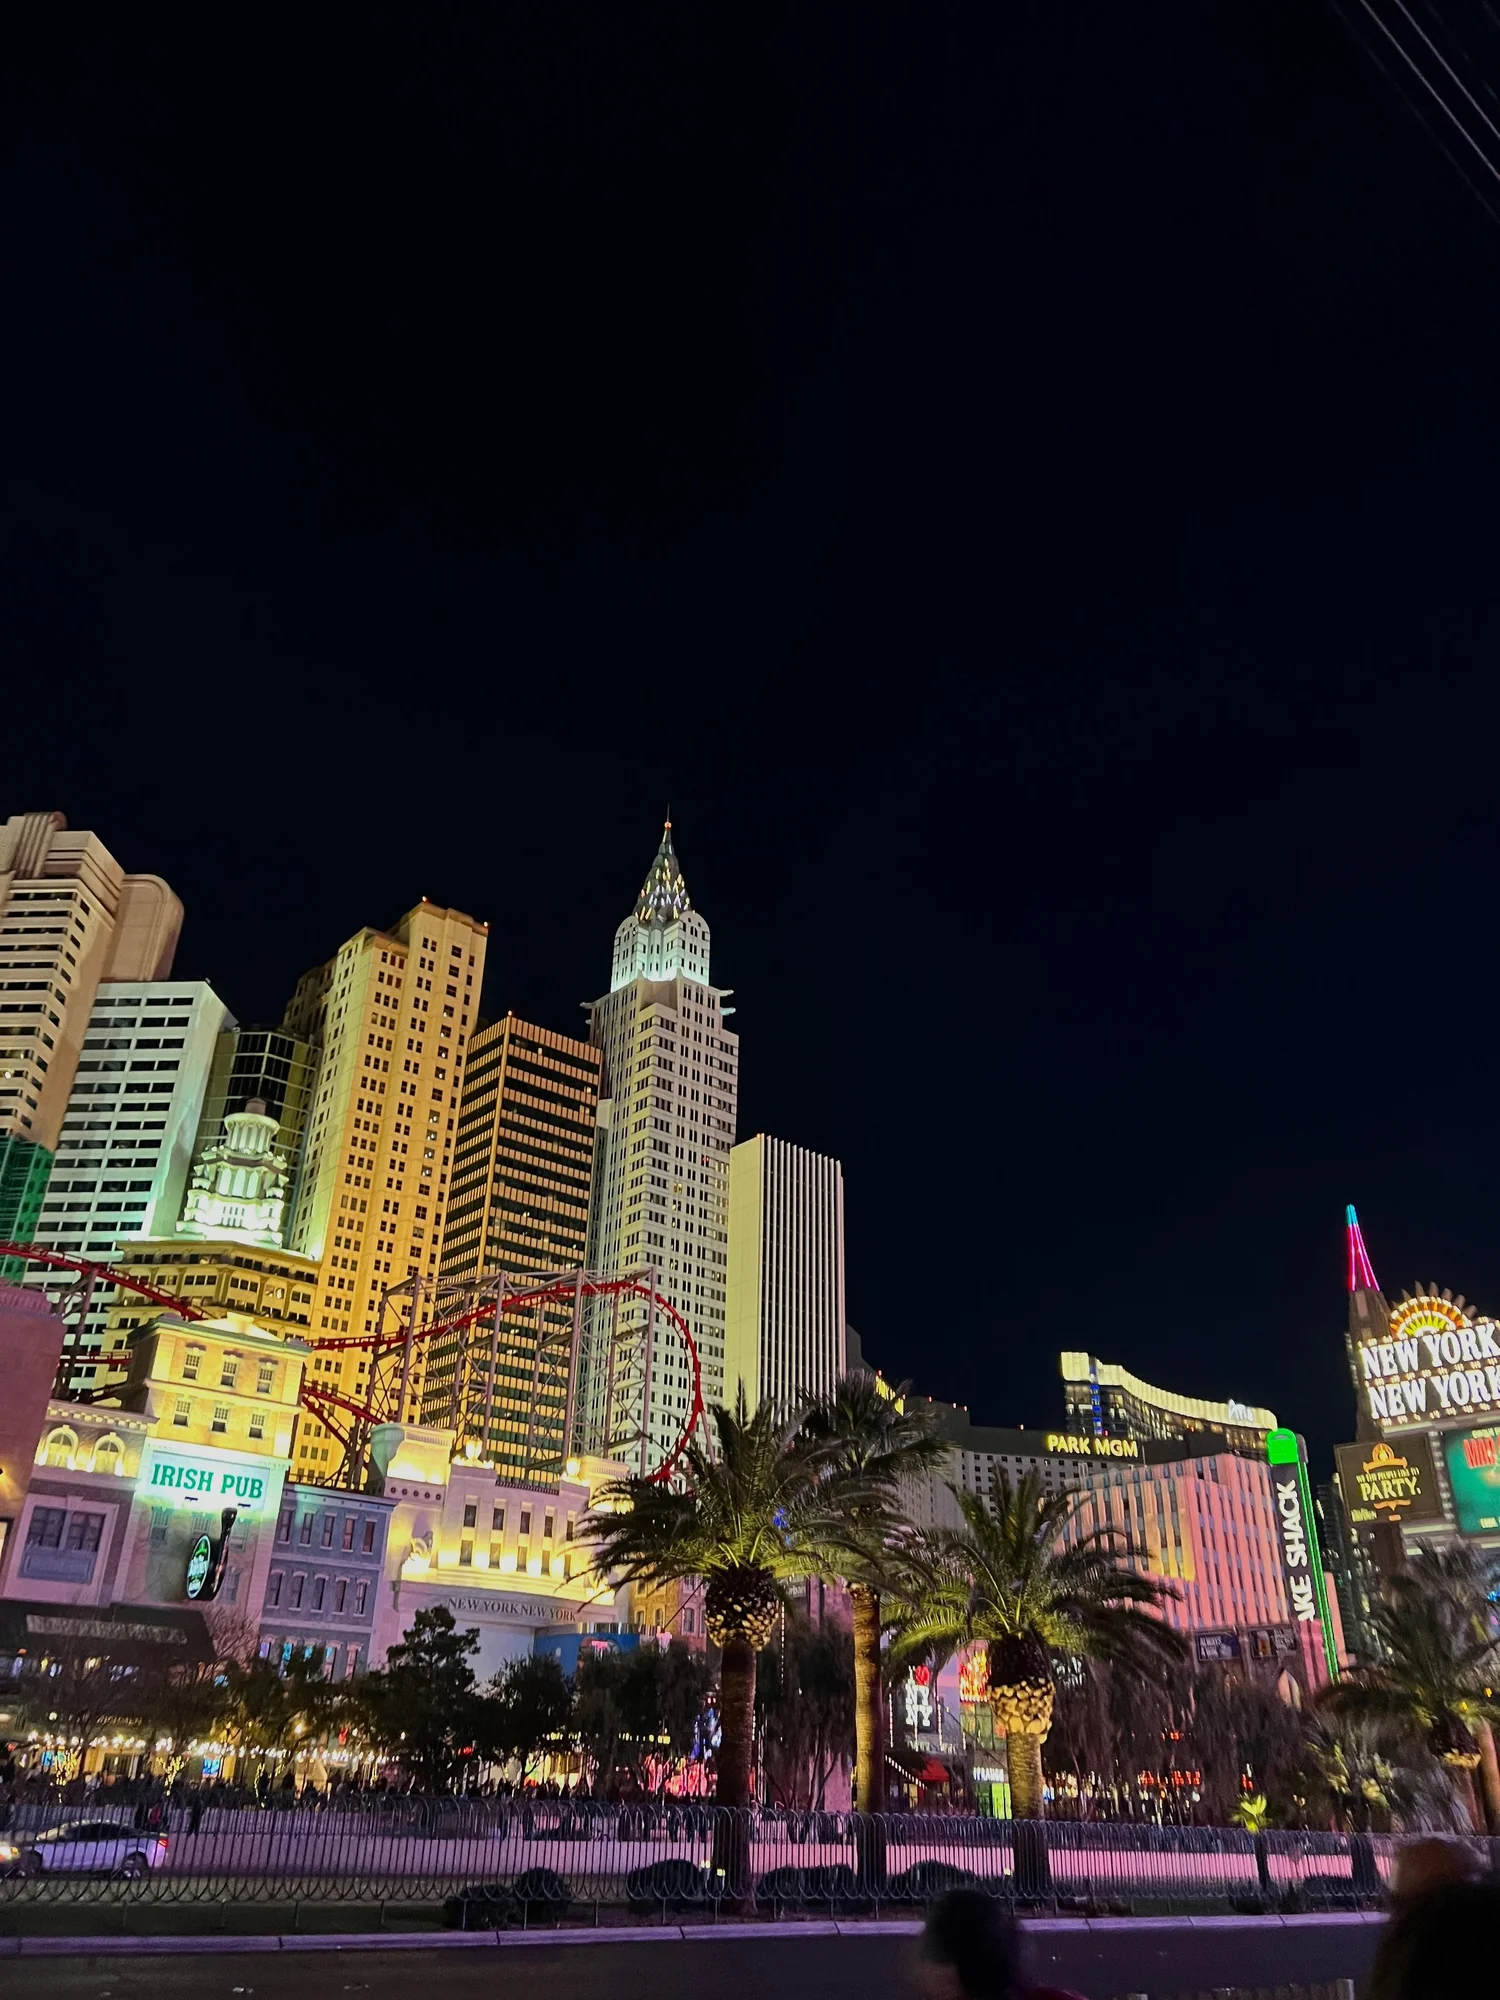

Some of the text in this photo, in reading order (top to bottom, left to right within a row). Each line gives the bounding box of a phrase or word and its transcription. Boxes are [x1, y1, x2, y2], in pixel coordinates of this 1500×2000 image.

[1359, 1322, 1500, 1380] NEW YORK
[1367, 1378, 1428, 1420] NEW
[1048, 1434, 1139, 1457] PARK MGM
[151, 1464, 263, 1499] IRISH PUB
[1276, 1479, 1307, 1568] SHACK
[448, 1597, 576, 1622] NEW YORK NEW YORK
[905, 1684, 930, 1705] NY
[905, 1704, 933, 1727] NY
